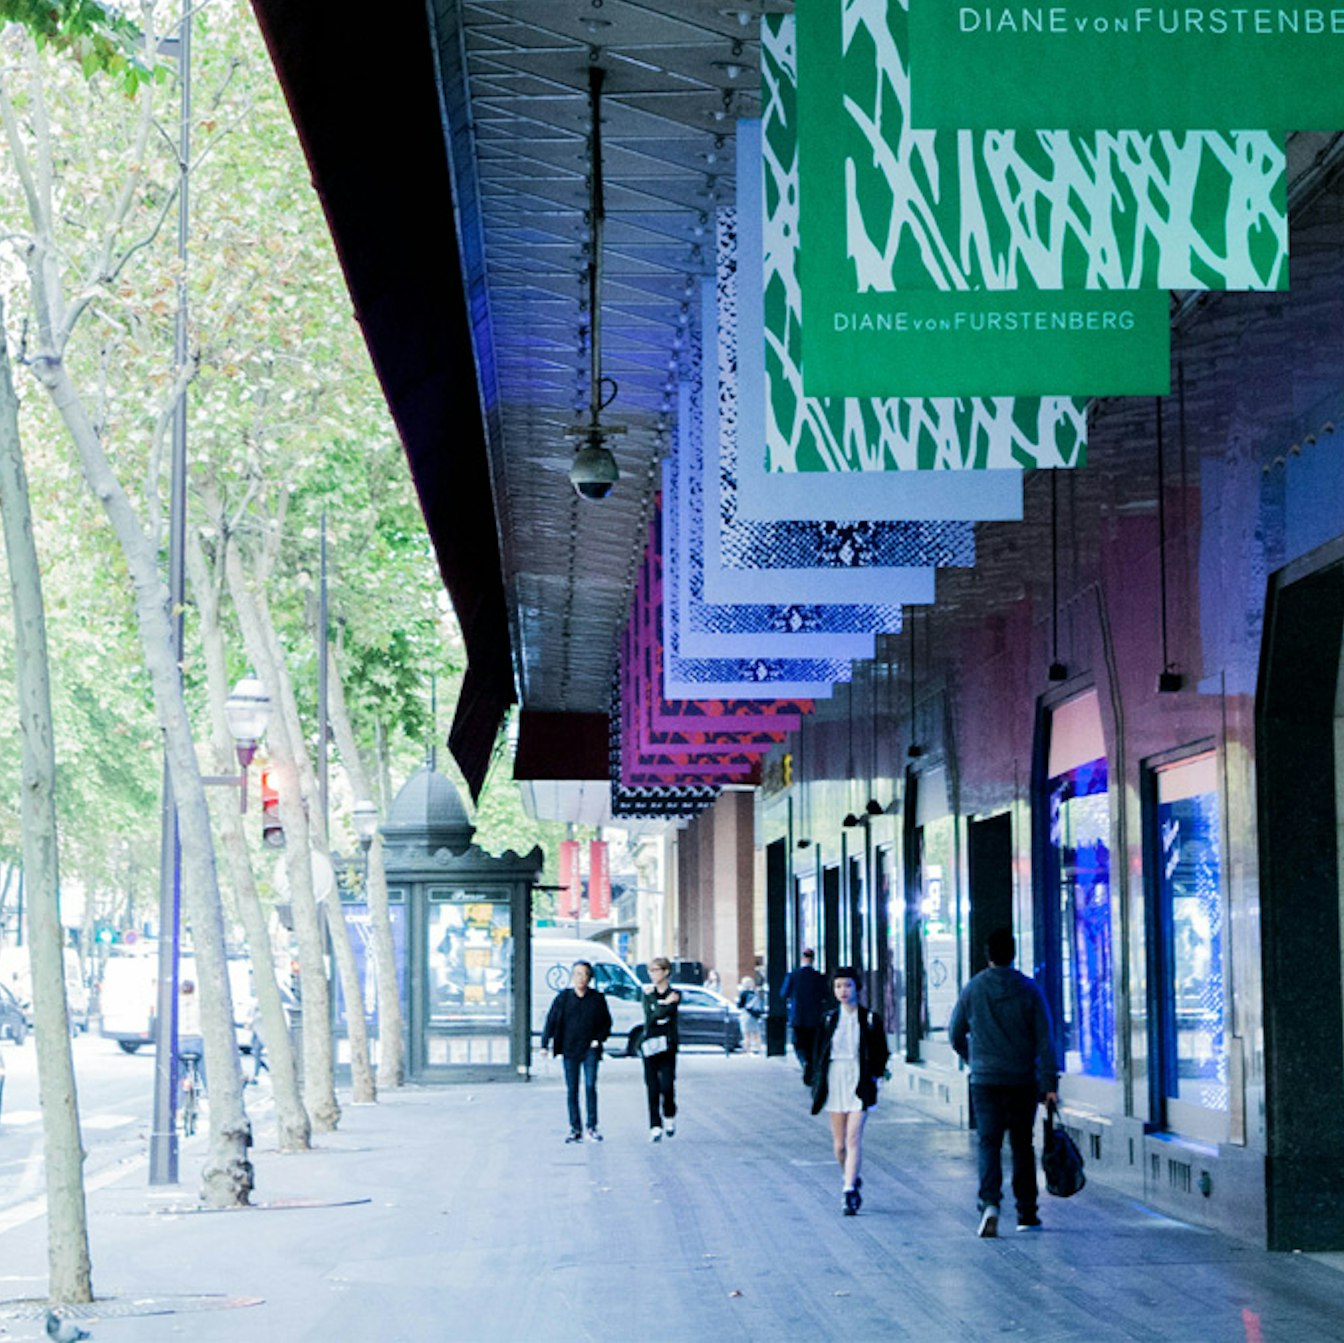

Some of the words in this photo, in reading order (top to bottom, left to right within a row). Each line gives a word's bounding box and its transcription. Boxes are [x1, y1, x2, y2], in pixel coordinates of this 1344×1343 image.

[959, 7, 1068, 33] DIANE
[834, 312, 908, 332] DIANE
[954, 311, 1135, 331] FURSTENBERG
